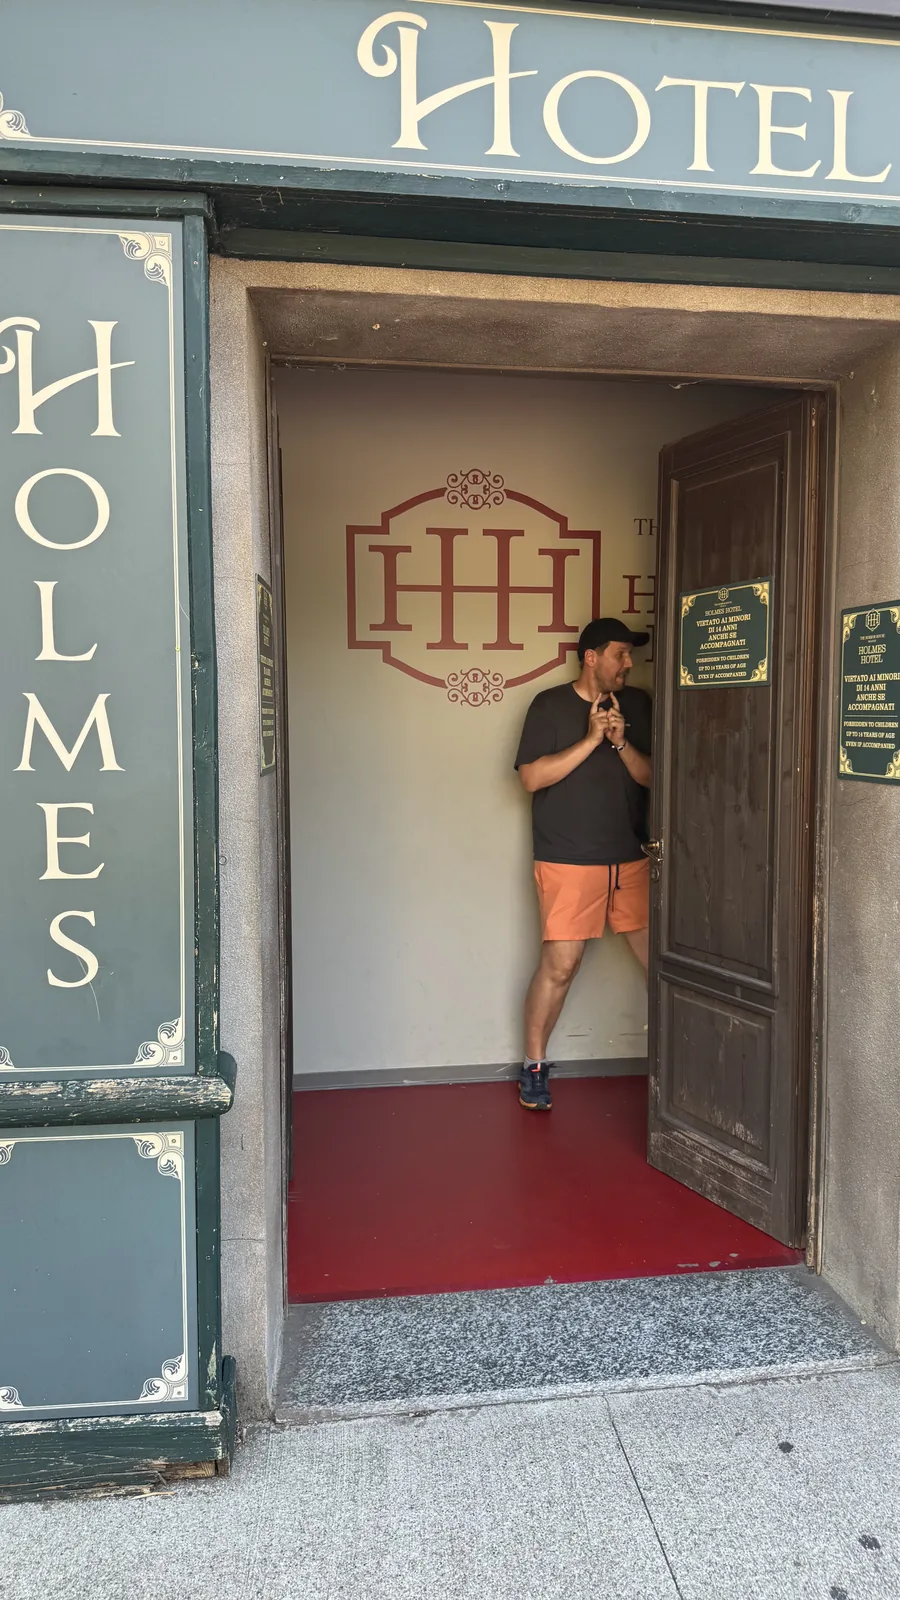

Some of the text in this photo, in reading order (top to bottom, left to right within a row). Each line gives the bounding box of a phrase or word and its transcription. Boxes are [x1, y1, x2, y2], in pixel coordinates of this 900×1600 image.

[356, 12, 893, 184] HOTEL
[704, 605, 742, 616] HOLMES HOTEL
[696, 618, 720, 627] VIETATO
[728, 614, 751, 622] MINORI
[722, 623, 737, 632] ANNI
[708, 633, 728, 641] ANCHE
[700, 639, 746, 650] ACCOMPAGNATI
[858, 644, 886, 655] HOLMES
[0, 316, 136, 990] HOLMES
[860, 654, 883, 664] HOTEL
[844, 672, 900, 682] VIETATO AI MINORI
[856, 683, 886, 692] DI 14 ANNI
[856, 693, 886, 701] ANCHE SE
[848, 703, 895, 711] ACCOMPAGNATI
